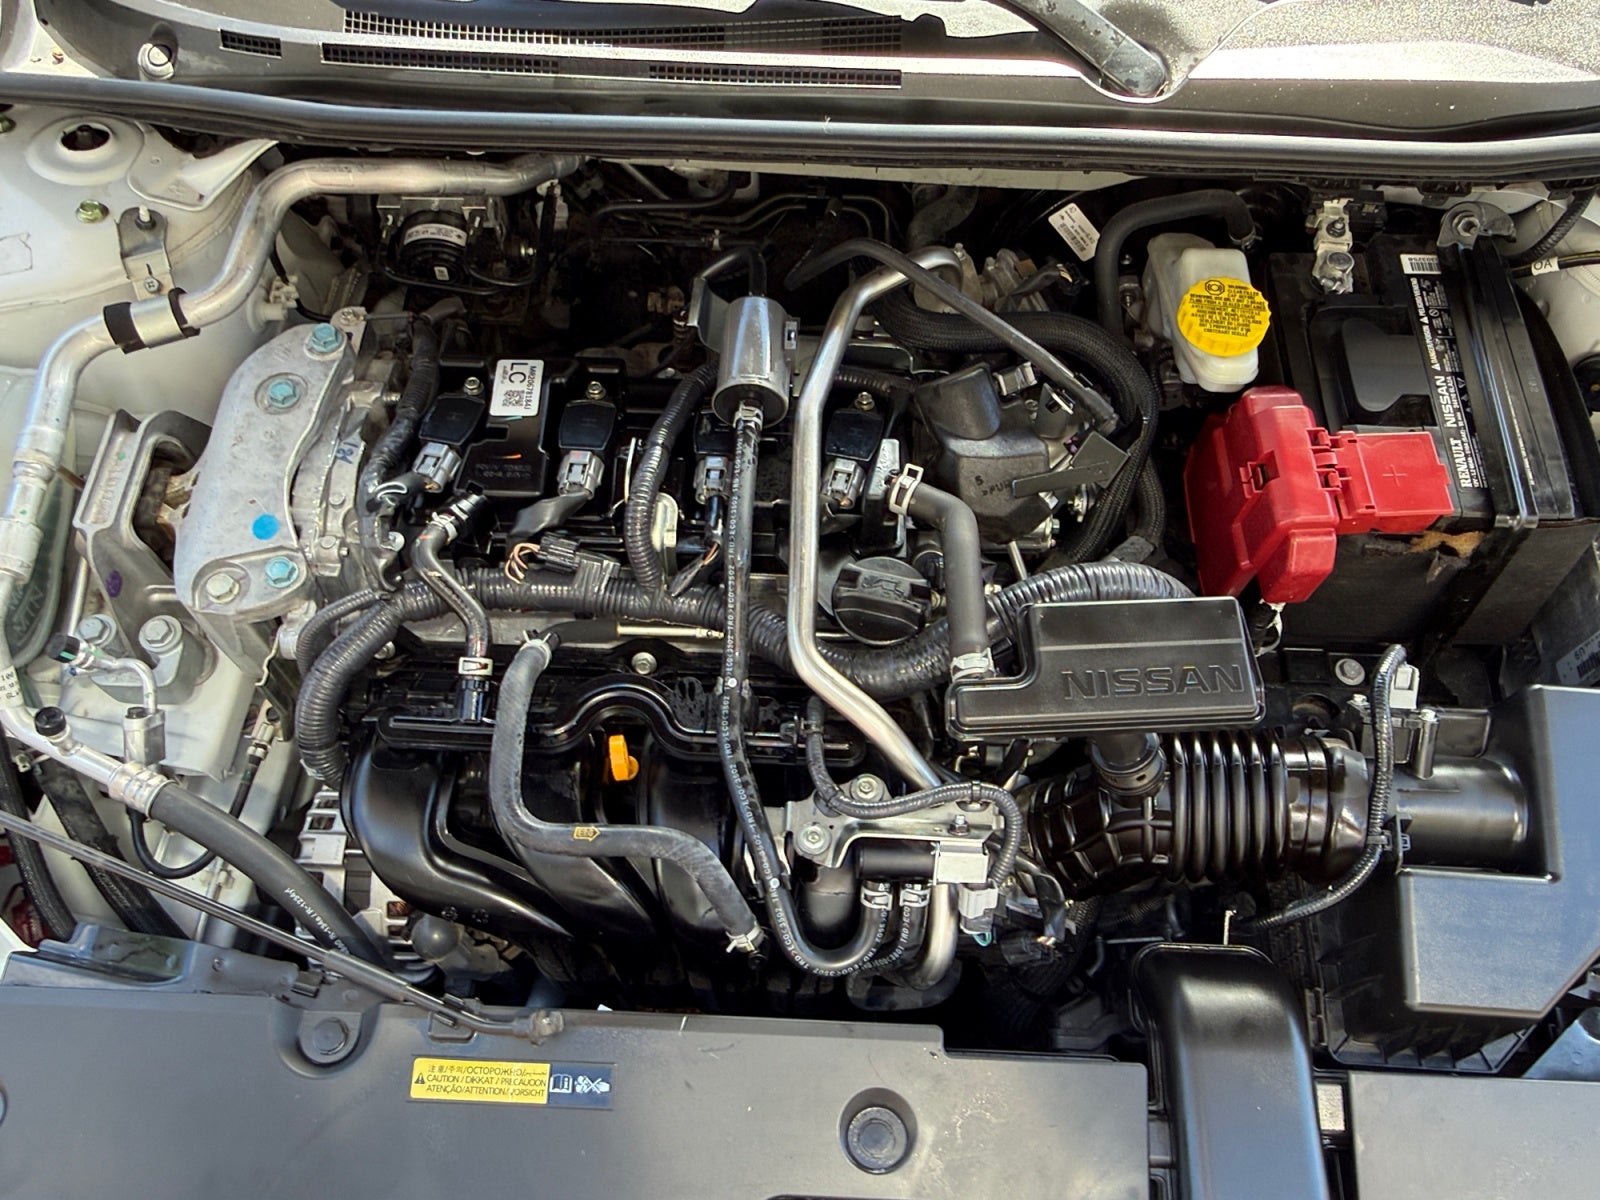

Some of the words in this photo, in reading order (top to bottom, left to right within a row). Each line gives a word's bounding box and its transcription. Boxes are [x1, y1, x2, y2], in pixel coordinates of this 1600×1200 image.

[508, 362, 528, 383] LC
[1434, 376, 1457, 427] NISSAN
[1449, 438, 1472, 487] RENAULT
[1060, 664, 1245, 700] NISSAN
[426, 1074, 460, 1082] CAUTION
[466, 1075, 494, 1084] DIKKAT
